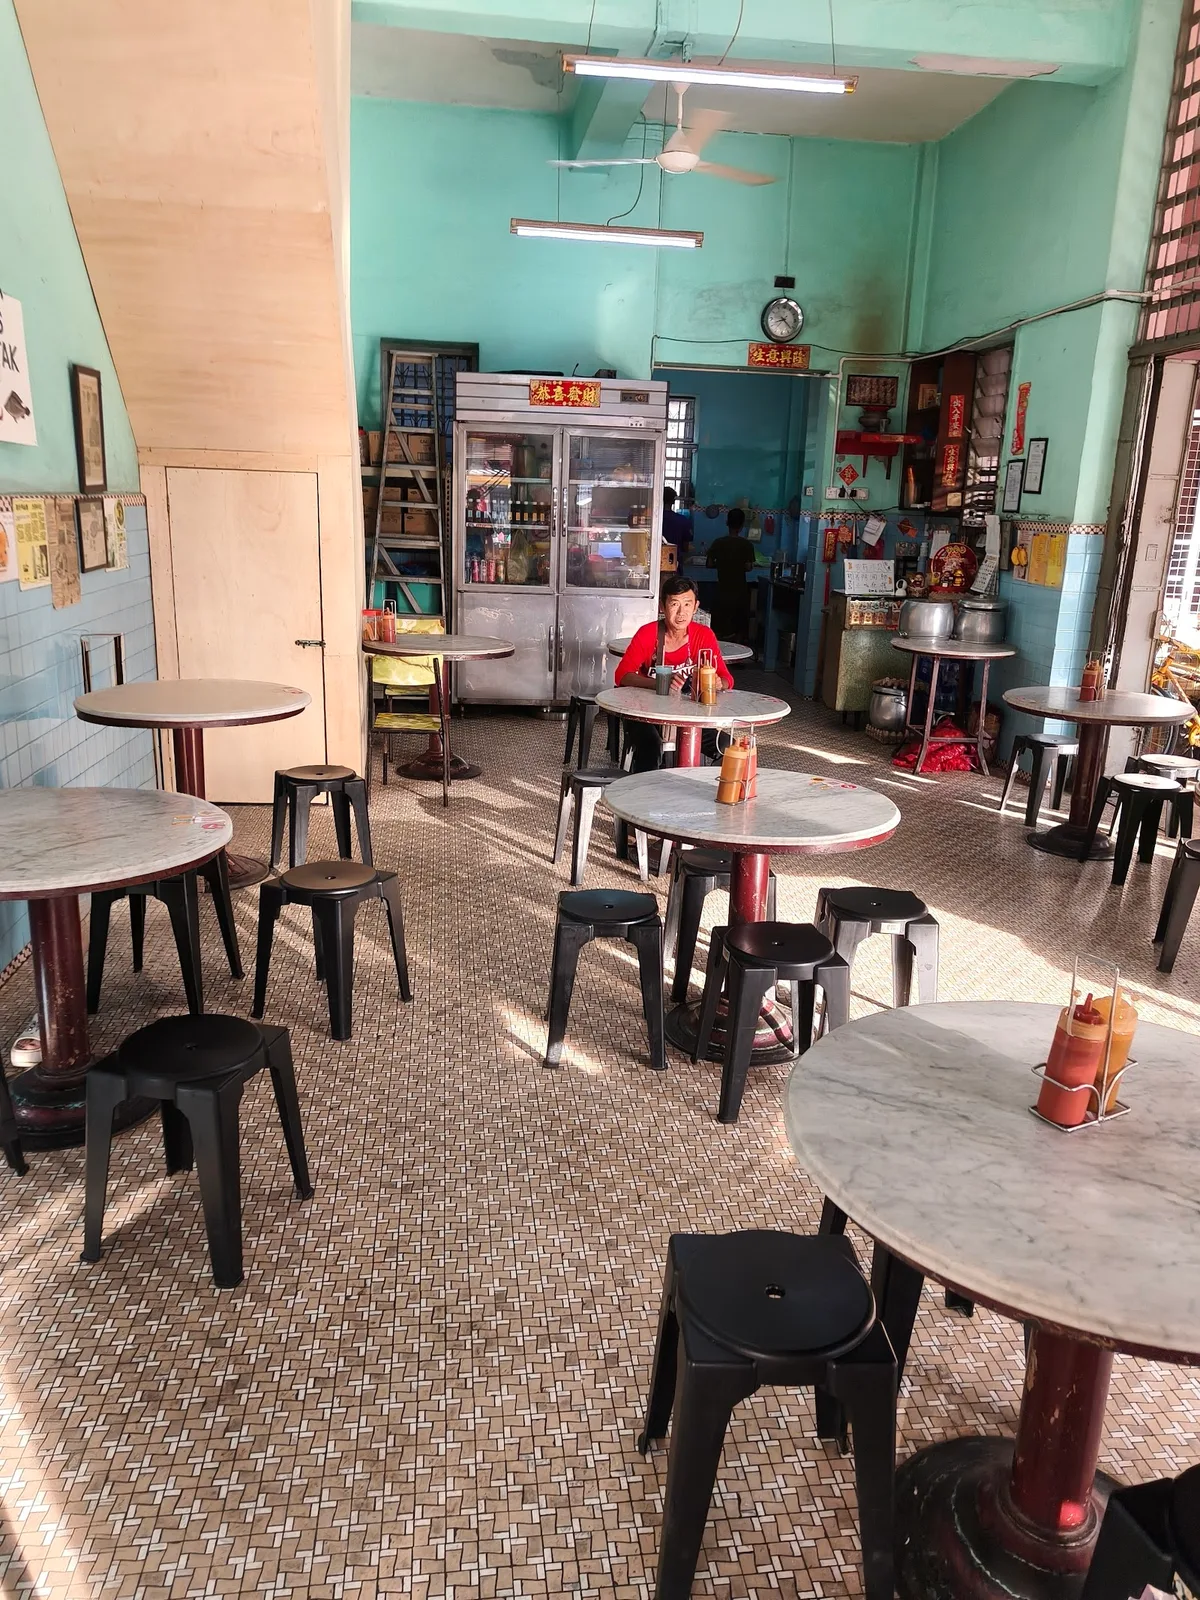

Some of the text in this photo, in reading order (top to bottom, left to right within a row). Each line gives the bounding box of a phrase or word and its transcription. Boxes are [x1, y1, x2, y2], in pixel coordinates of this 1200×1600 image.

[753, 348, 804, 364] 生意興隆
[536, 385, 597, 402] 恭喜發財
